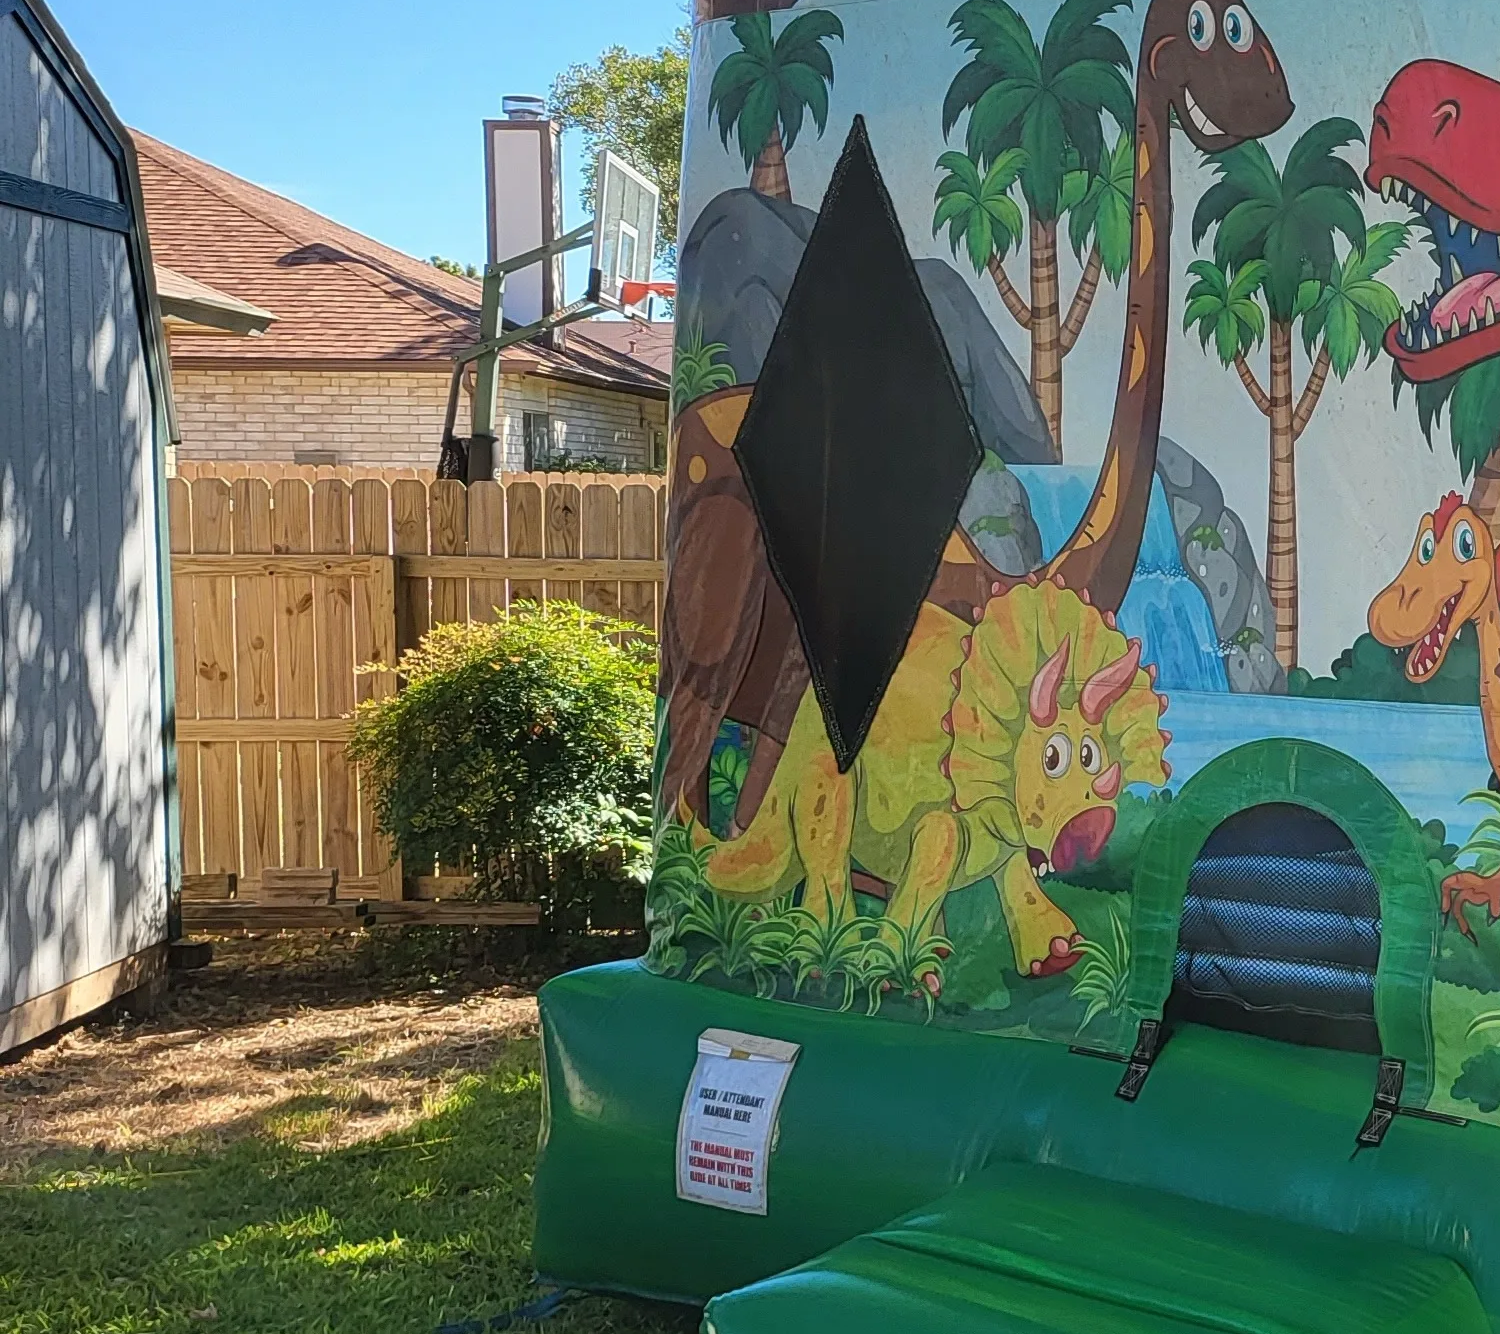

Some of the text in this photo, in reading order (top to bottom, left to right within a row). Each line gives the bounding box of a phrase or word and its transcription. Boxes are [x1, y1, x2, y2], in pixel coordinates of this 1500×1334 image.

[699, 1087, 765, 1108] USER ATTENDANT
[703, 1104, 752, 1123] MANUAL HERE
[691, 1140, 754, 1162] THE MANUAL MUST
[689, 1155, 753, 1178] REMAIN WITH THIS
[690, 1171, 751, 1193] RIDE AT ALL TIMES
